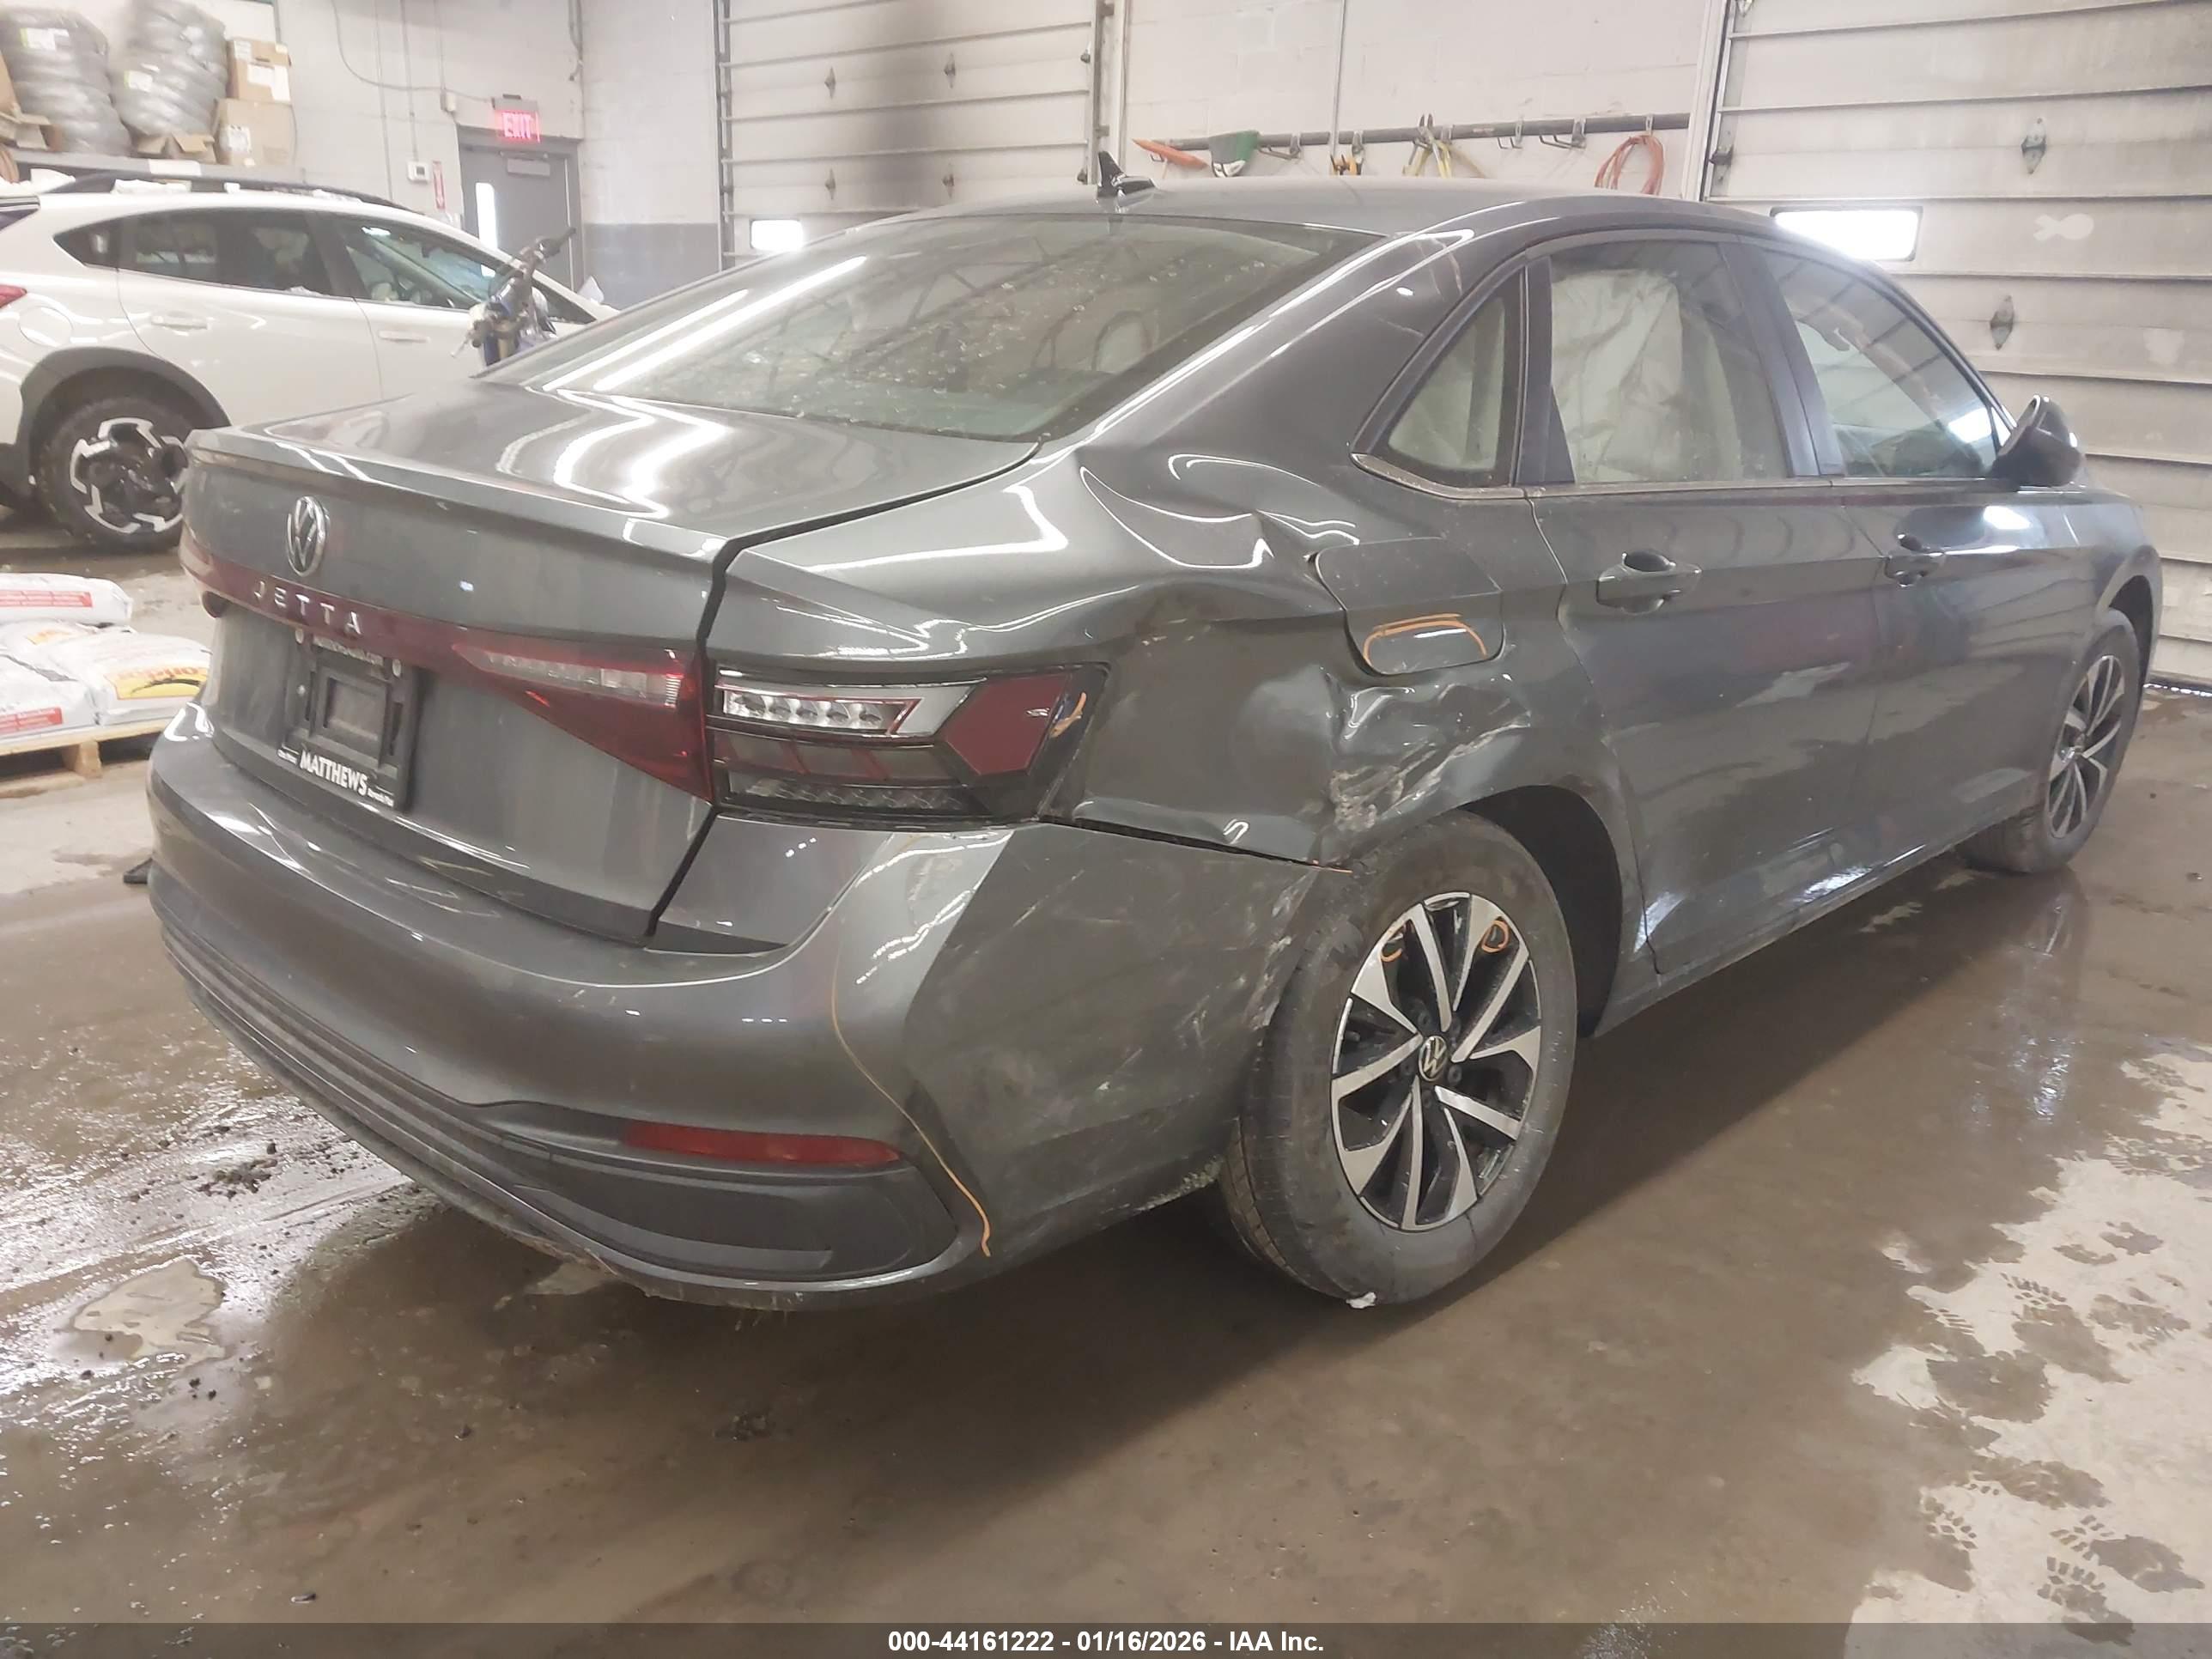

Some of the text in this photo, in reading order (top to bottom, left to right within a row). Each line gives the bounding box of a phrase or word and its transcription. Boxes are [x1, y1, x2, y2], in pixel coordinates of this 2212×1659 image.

[501, 112, 533, 138] EXIT
[253, 580, 363, 635] JETTA
[300, 750, 368, 796] MATTHEWS
